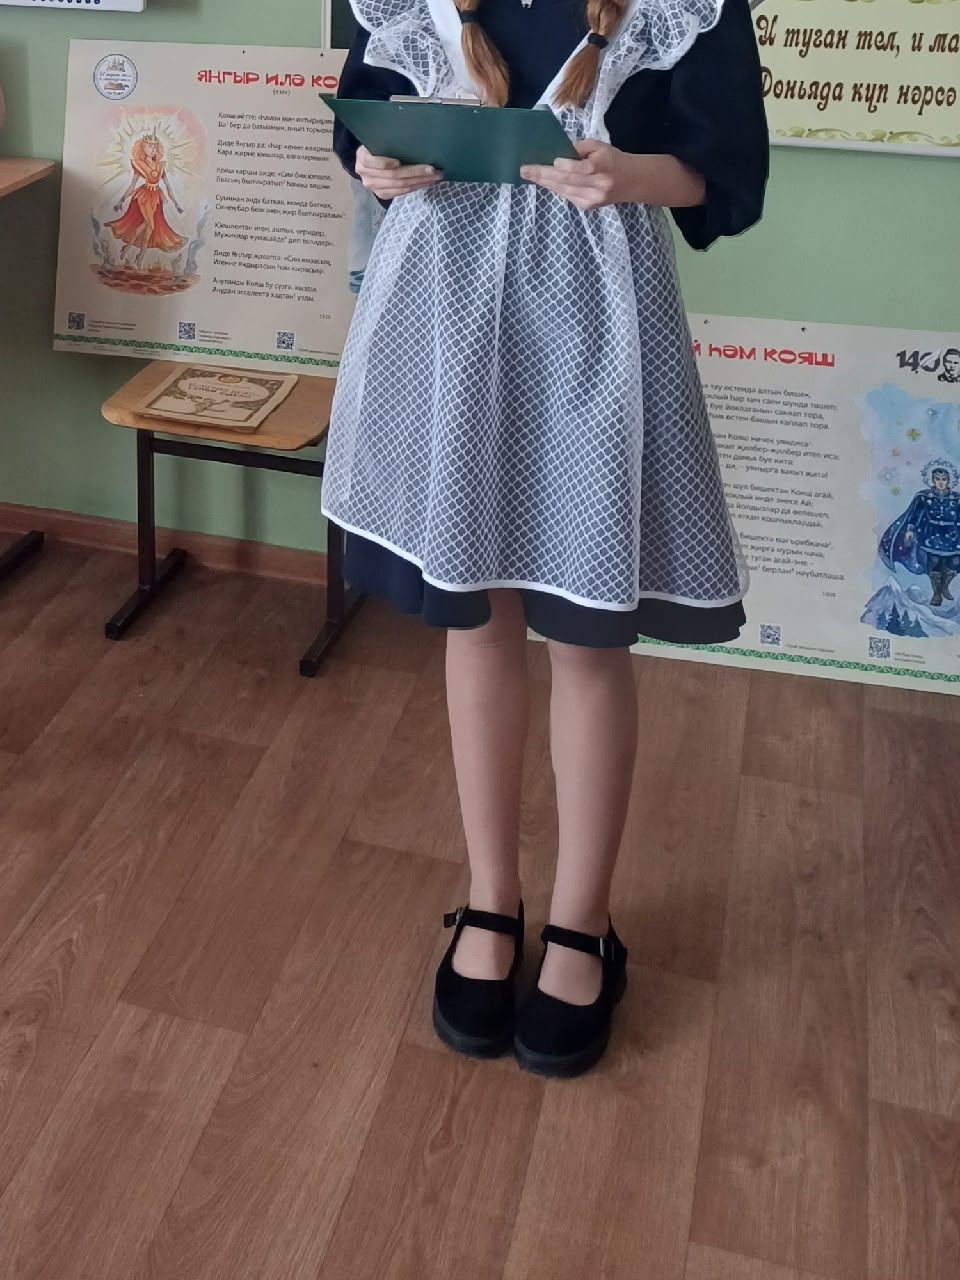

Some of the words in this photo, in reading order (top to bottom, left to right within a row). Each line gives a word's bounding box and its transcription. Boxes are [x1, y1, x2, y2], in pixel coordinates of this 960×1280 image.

[783, 28, 849, 58] туган
[856, 30, 901, 58] тел,
[911, 32, 924, 52] и
[197, 70, 260, 85] ЯҢГЫР
[266, 73, 305, 87] ИЛӘ
[897, 85, 957, 116] нәрсә
[709, 343, 756, 361] ҺӘМ
[764, 348, 836, 367] КОЯШ
